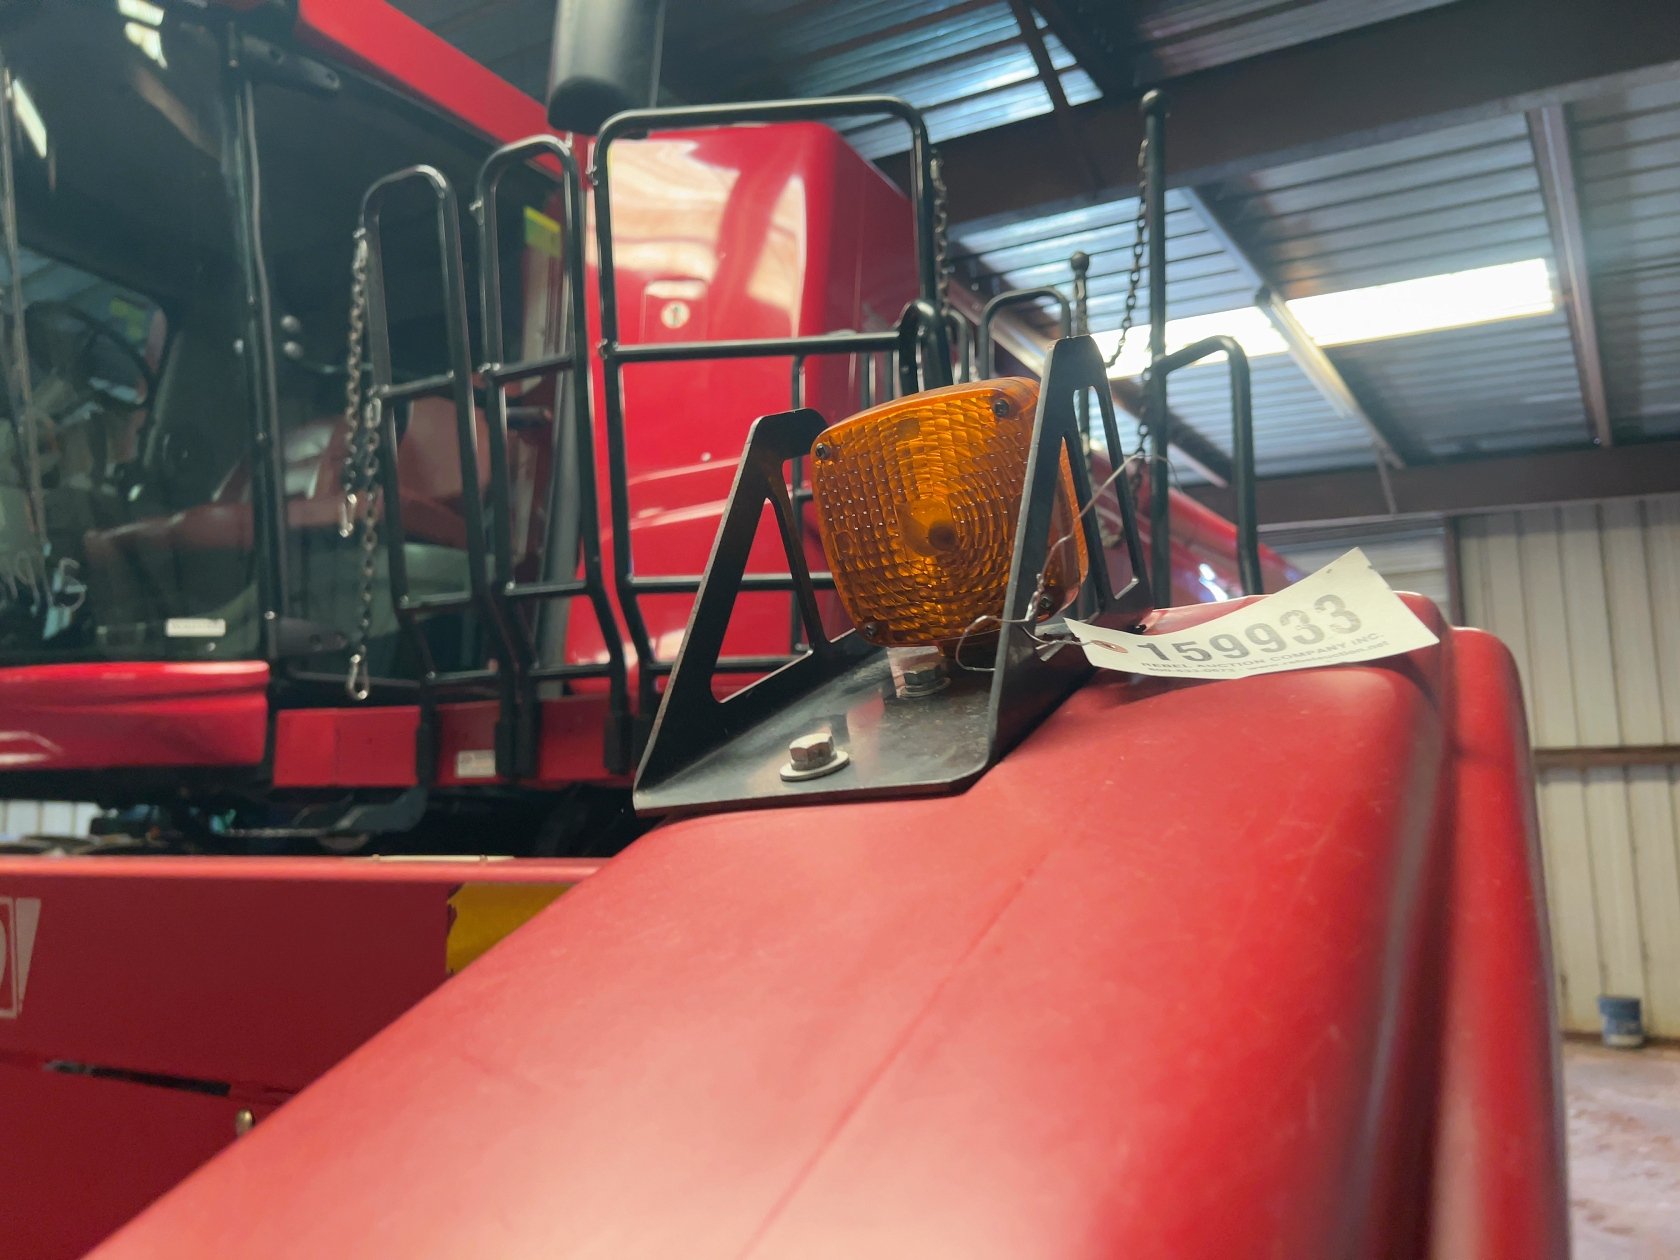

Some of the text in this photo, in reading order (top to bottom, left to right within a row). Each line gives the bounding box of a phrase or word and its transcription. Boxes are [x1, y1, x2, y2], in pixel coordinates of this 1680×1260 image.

[1137, 594, 1362, 662] 159933
[1141, 632, 1384, 669] REBEL AUCTION COMPANY INC.
